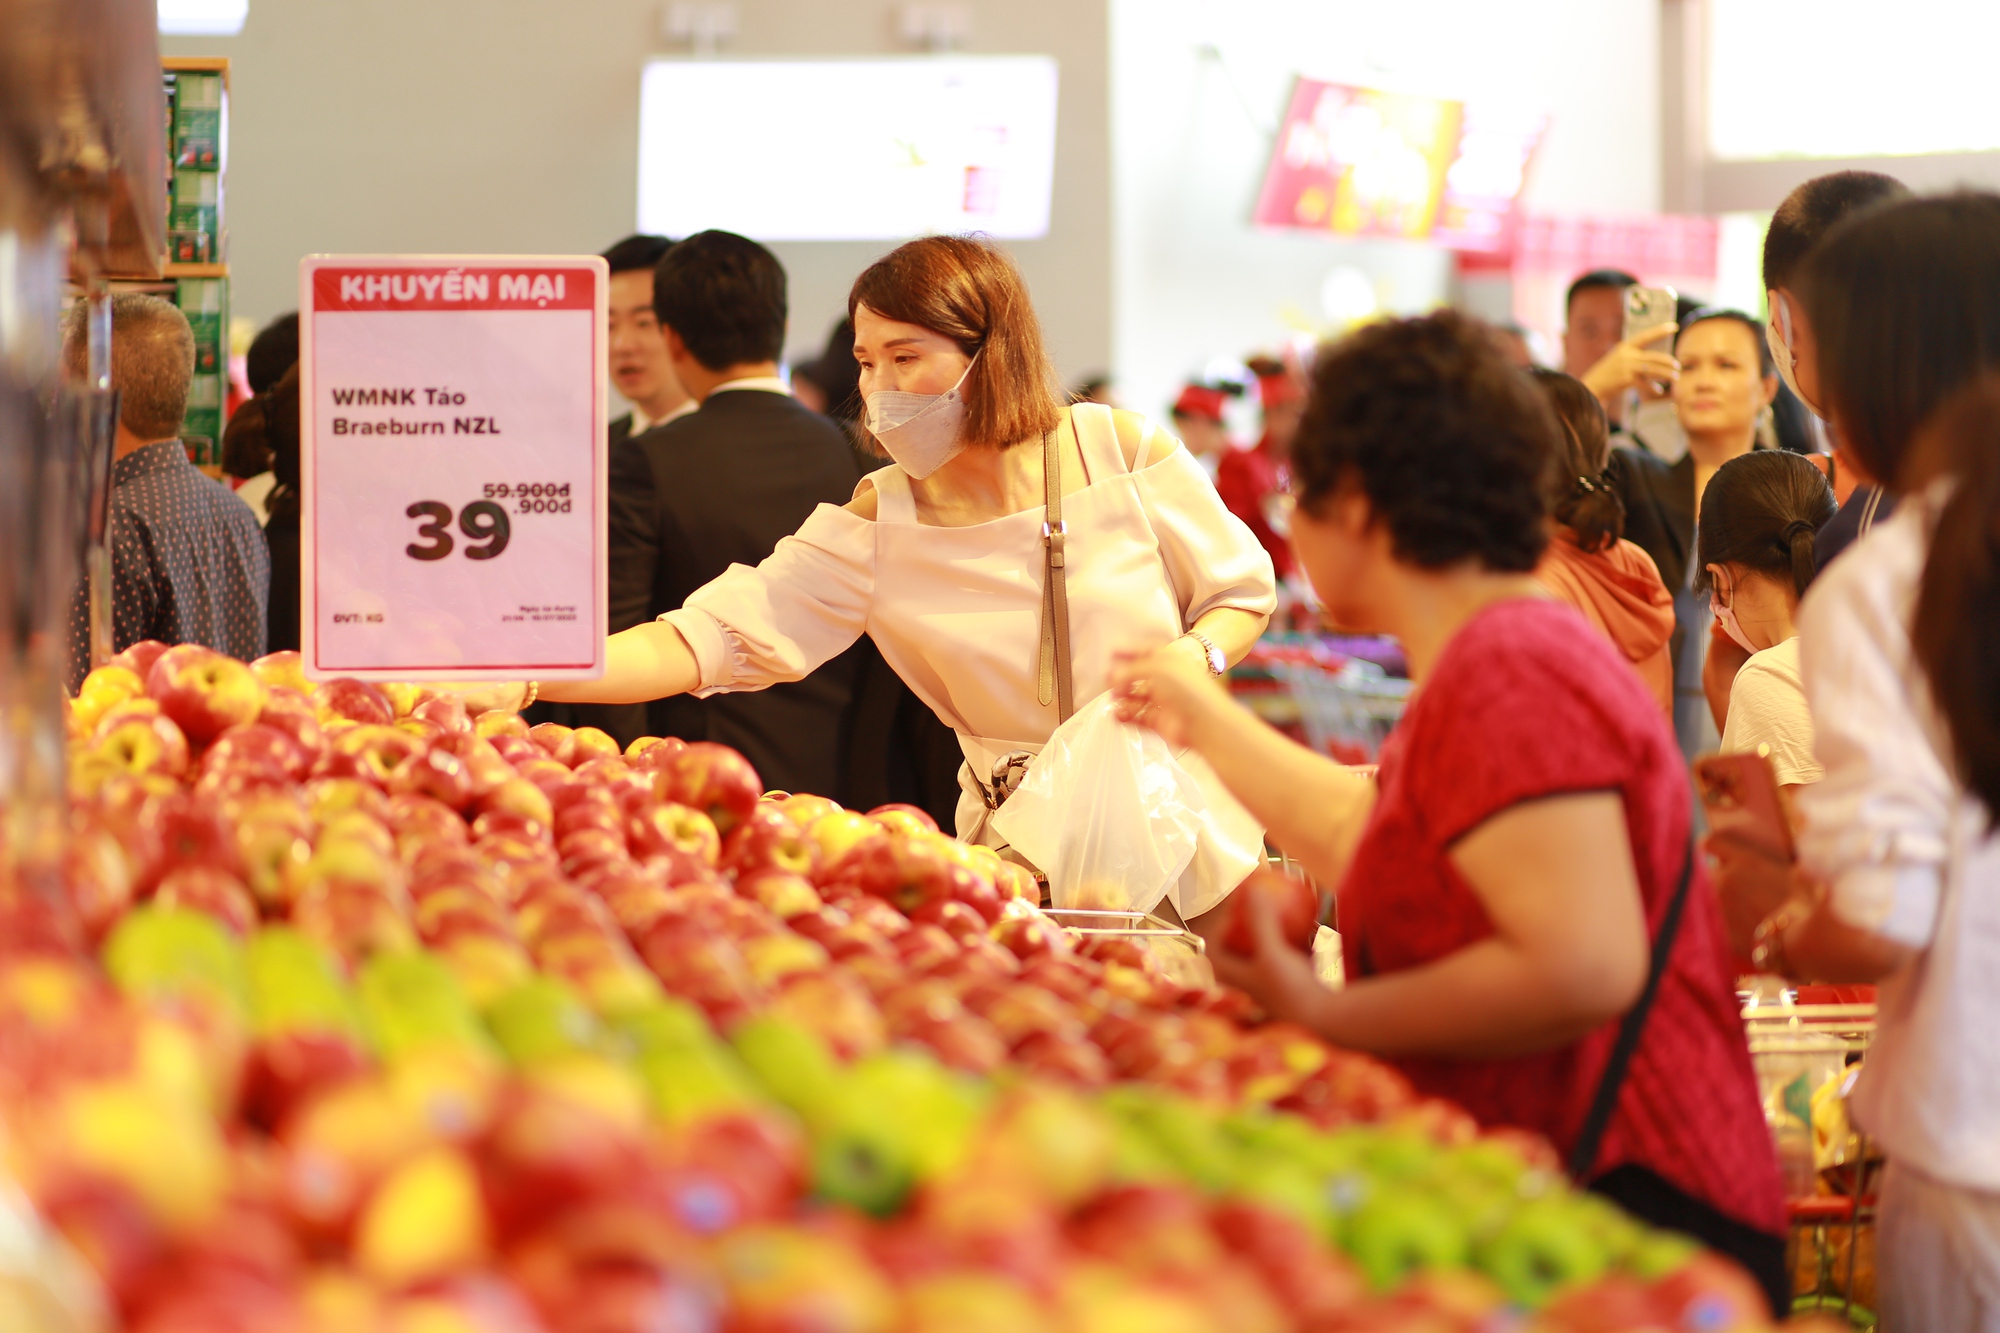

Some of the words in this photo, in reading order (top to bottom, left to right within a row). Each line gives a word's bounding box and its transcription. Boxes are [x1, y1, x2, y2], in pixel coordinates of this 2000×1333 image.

[340, 267, 489, 301] KHUYẾN
[498, 274, 565, 307] MẠI
[331, 388, 416, 406] WMNK
[424, 387, 466, 406] Táo
[332, 417, 445, 435] Braeburn
[453, 417, 501, 435] NZL
[405, 500, 511, 561] 39
